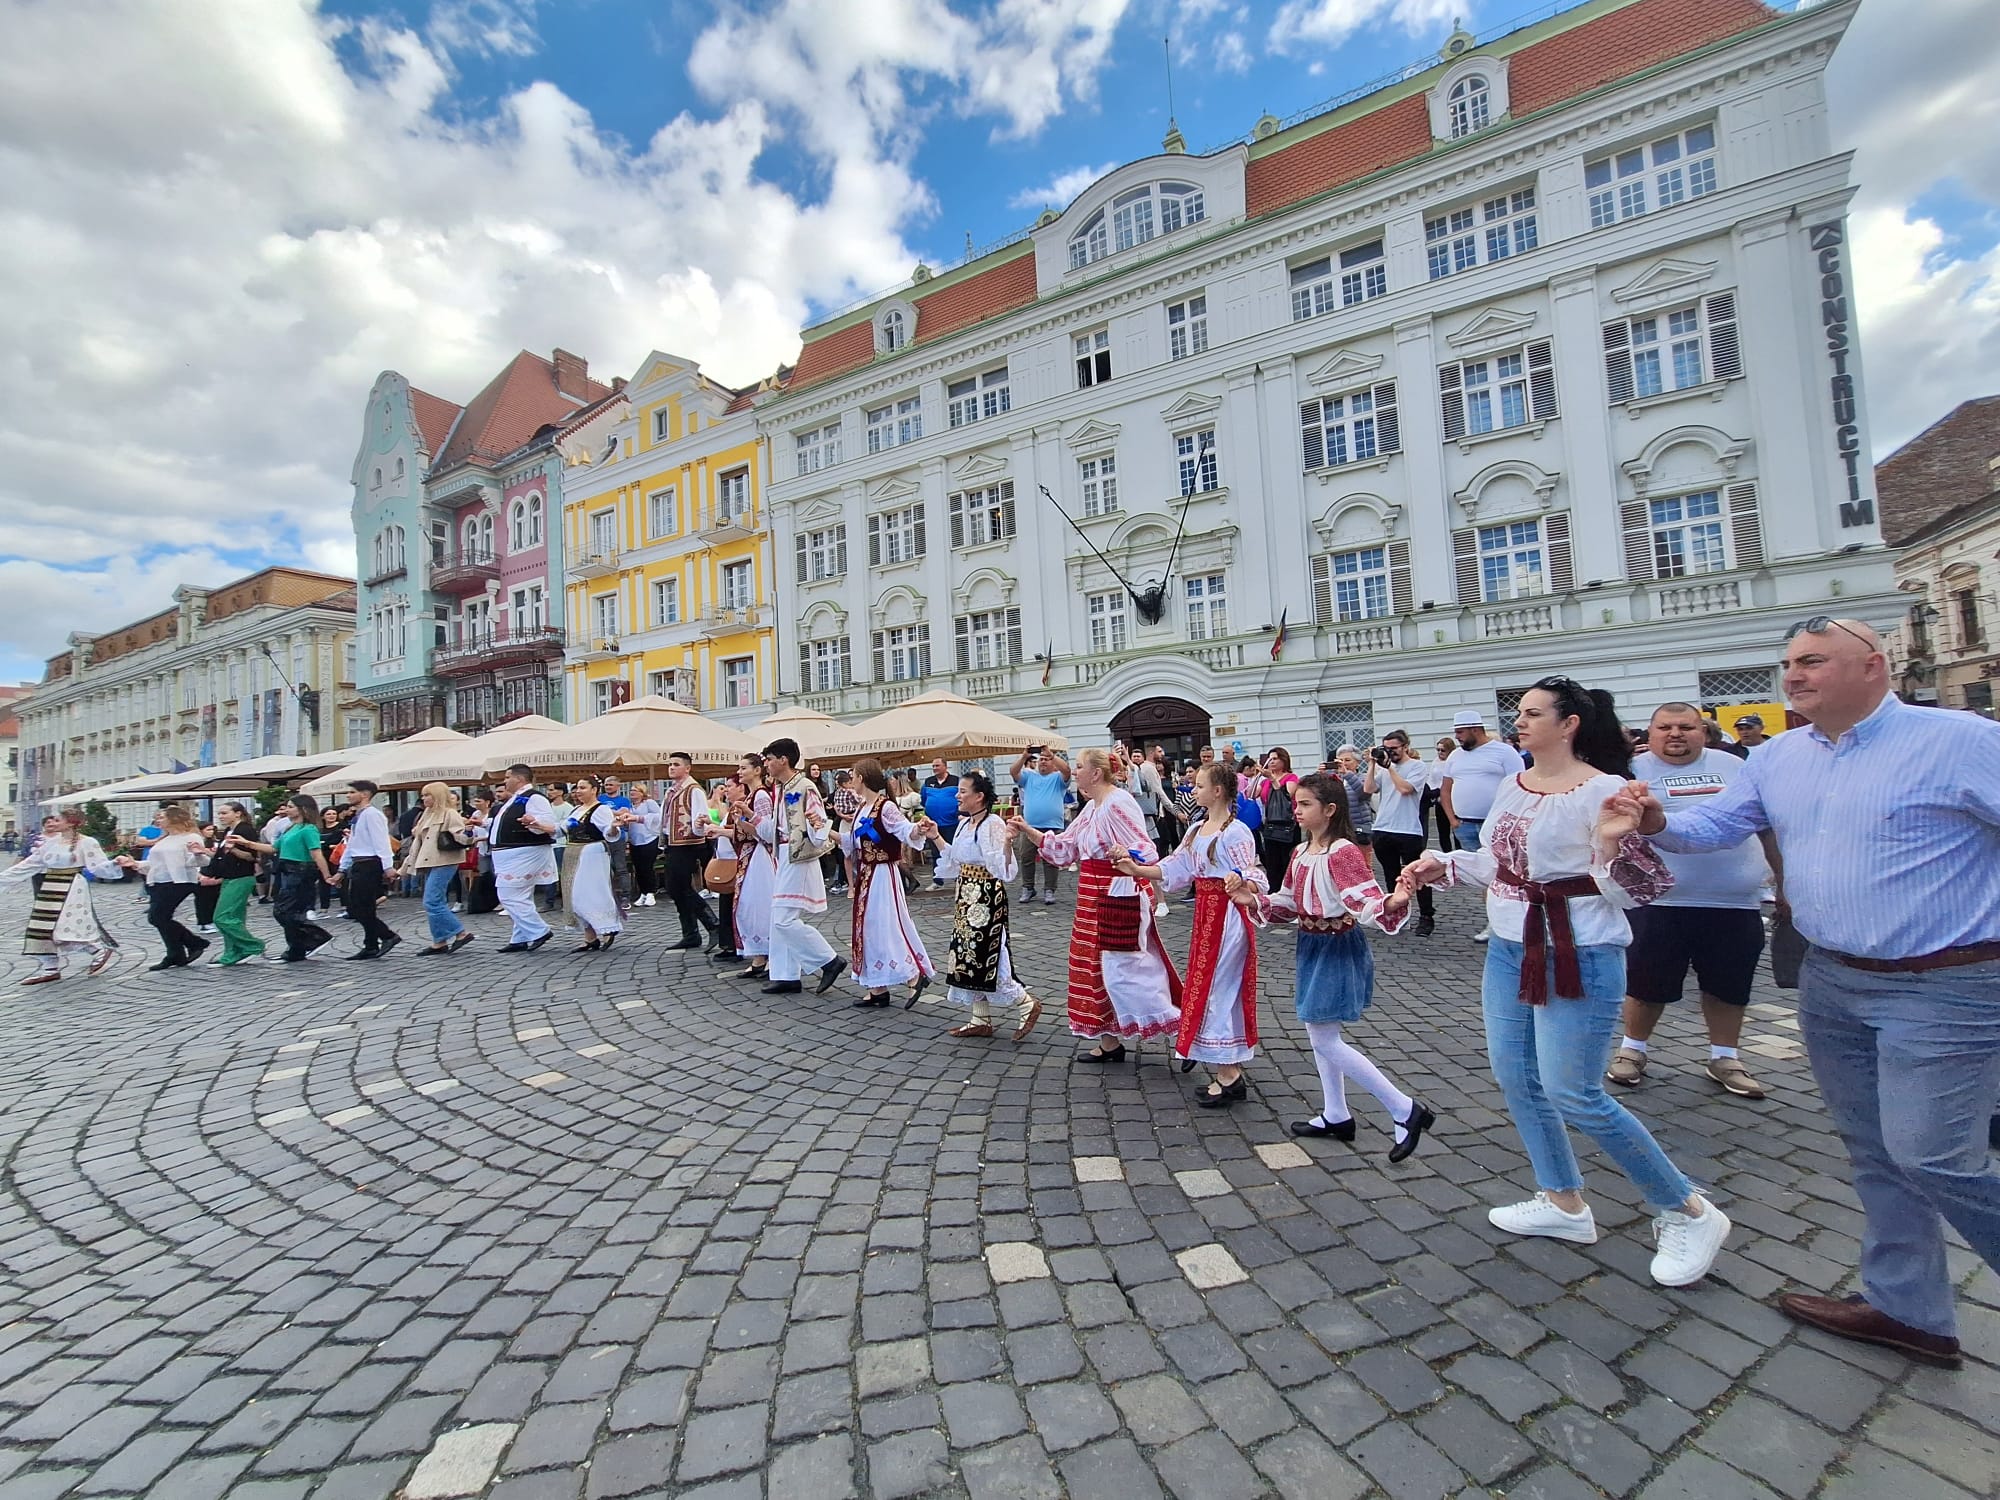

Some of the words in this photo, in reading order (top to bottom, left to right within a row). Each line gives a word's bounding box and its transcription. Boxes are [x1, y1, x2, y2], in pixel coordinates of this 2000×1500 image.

[1818, 247, 1874, 527] CONSTRUCTIM
[824, 744, 856, 754] POVESTEA
[860, 742, 882, 751] MERGE
[886, 740, 899, 749] MAI
[903, 737, 936, 748] DEPARTE
[704, 752, 730, 761] MERGE
[1666, 775, 1721, 787] HIGHLIFE
